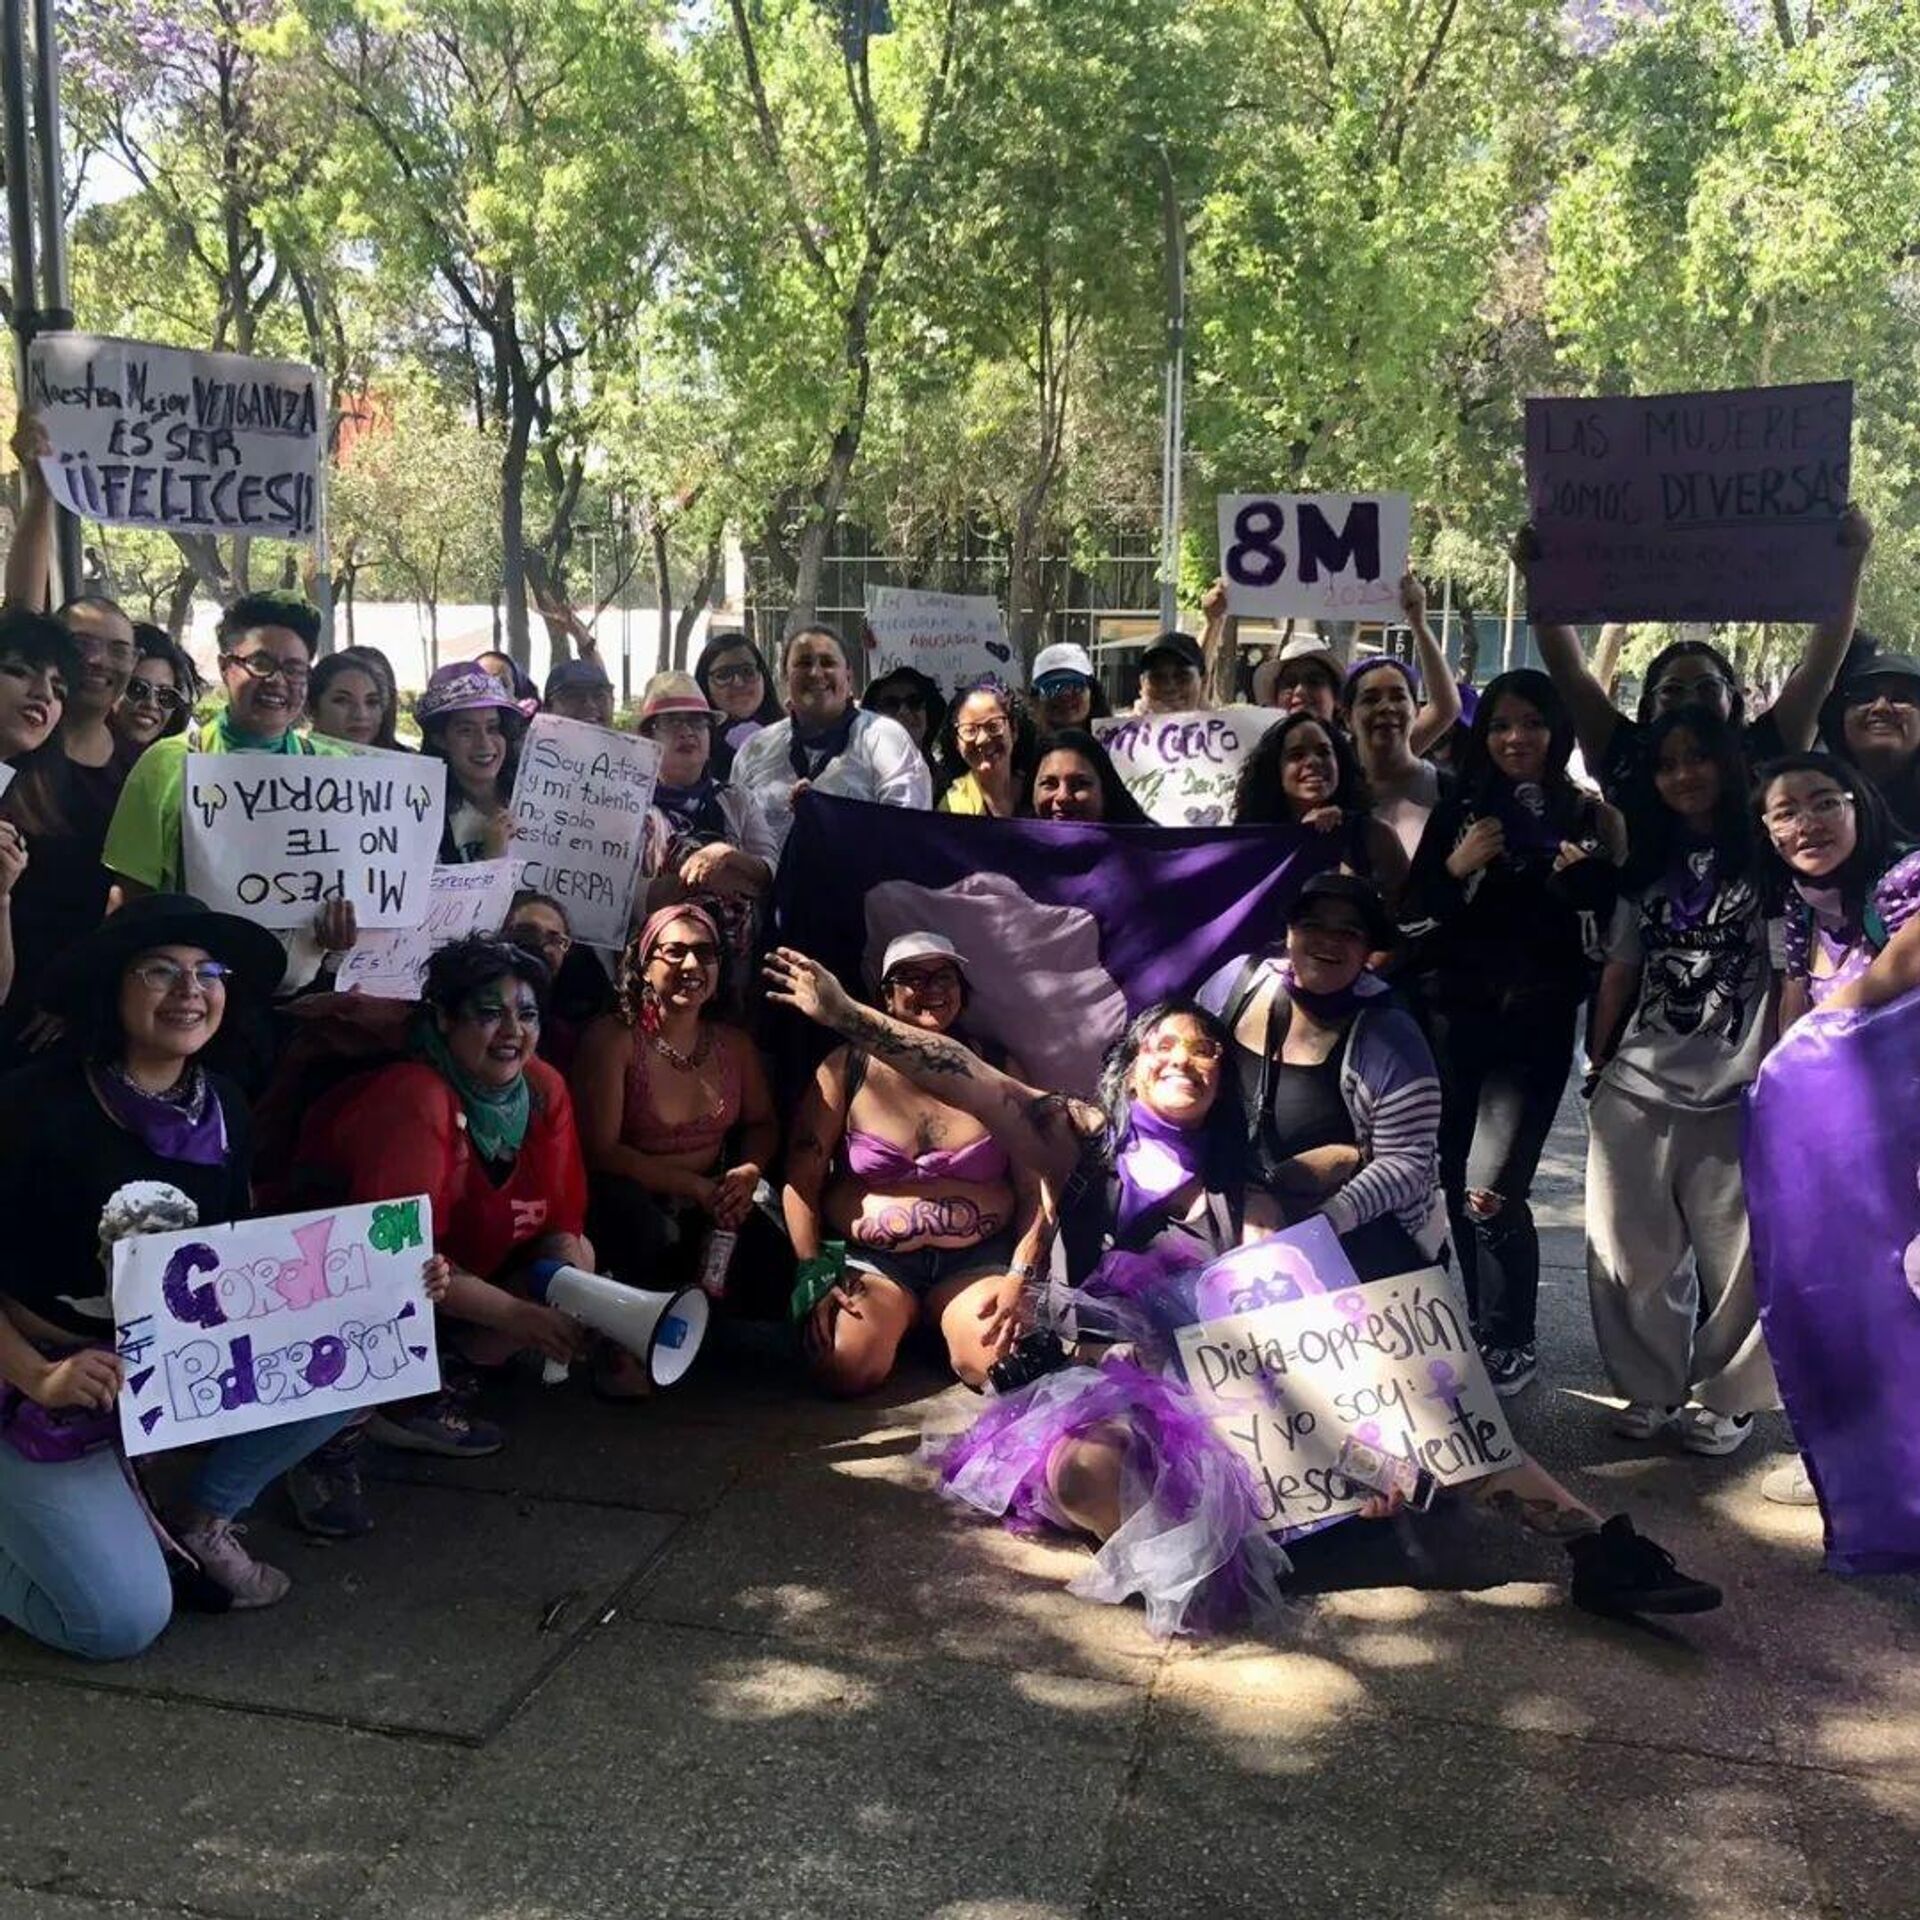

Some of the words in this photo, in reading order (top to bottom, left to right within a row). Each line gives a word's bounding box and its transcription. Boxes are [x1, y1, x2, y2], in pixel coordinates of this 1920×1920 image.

[193, 375, 317, 433] VENGANZA
[108, 418, 153, 457] ES
[166, 422, 242, 466] SER
[1544, 411, 1610, 459] LAS
[1226, 501, 1381, 587] 8M
[535, 739, 585, 781] Soy
[591, 752, 649, 787] Actriz
[233, 776, 394, 821] IMPORTA
[519, 800, 546, 821] no
[554, 809, 596, 831] solo
[543, 779, 572, 799] mi
[580, 781, 641, 815] talento
[286, 828, 340, 856] TE
[359, 826, 399, 855] NO
[569, 837, 593, 851] en
[602, 840, 631, 860] mi
[237, 869, 345, 905] PESO
[368, 867, 407, 914] MI
[521, 861, 615, 908] CUERPA
[1272, 1409, 1317, 1451] yo
